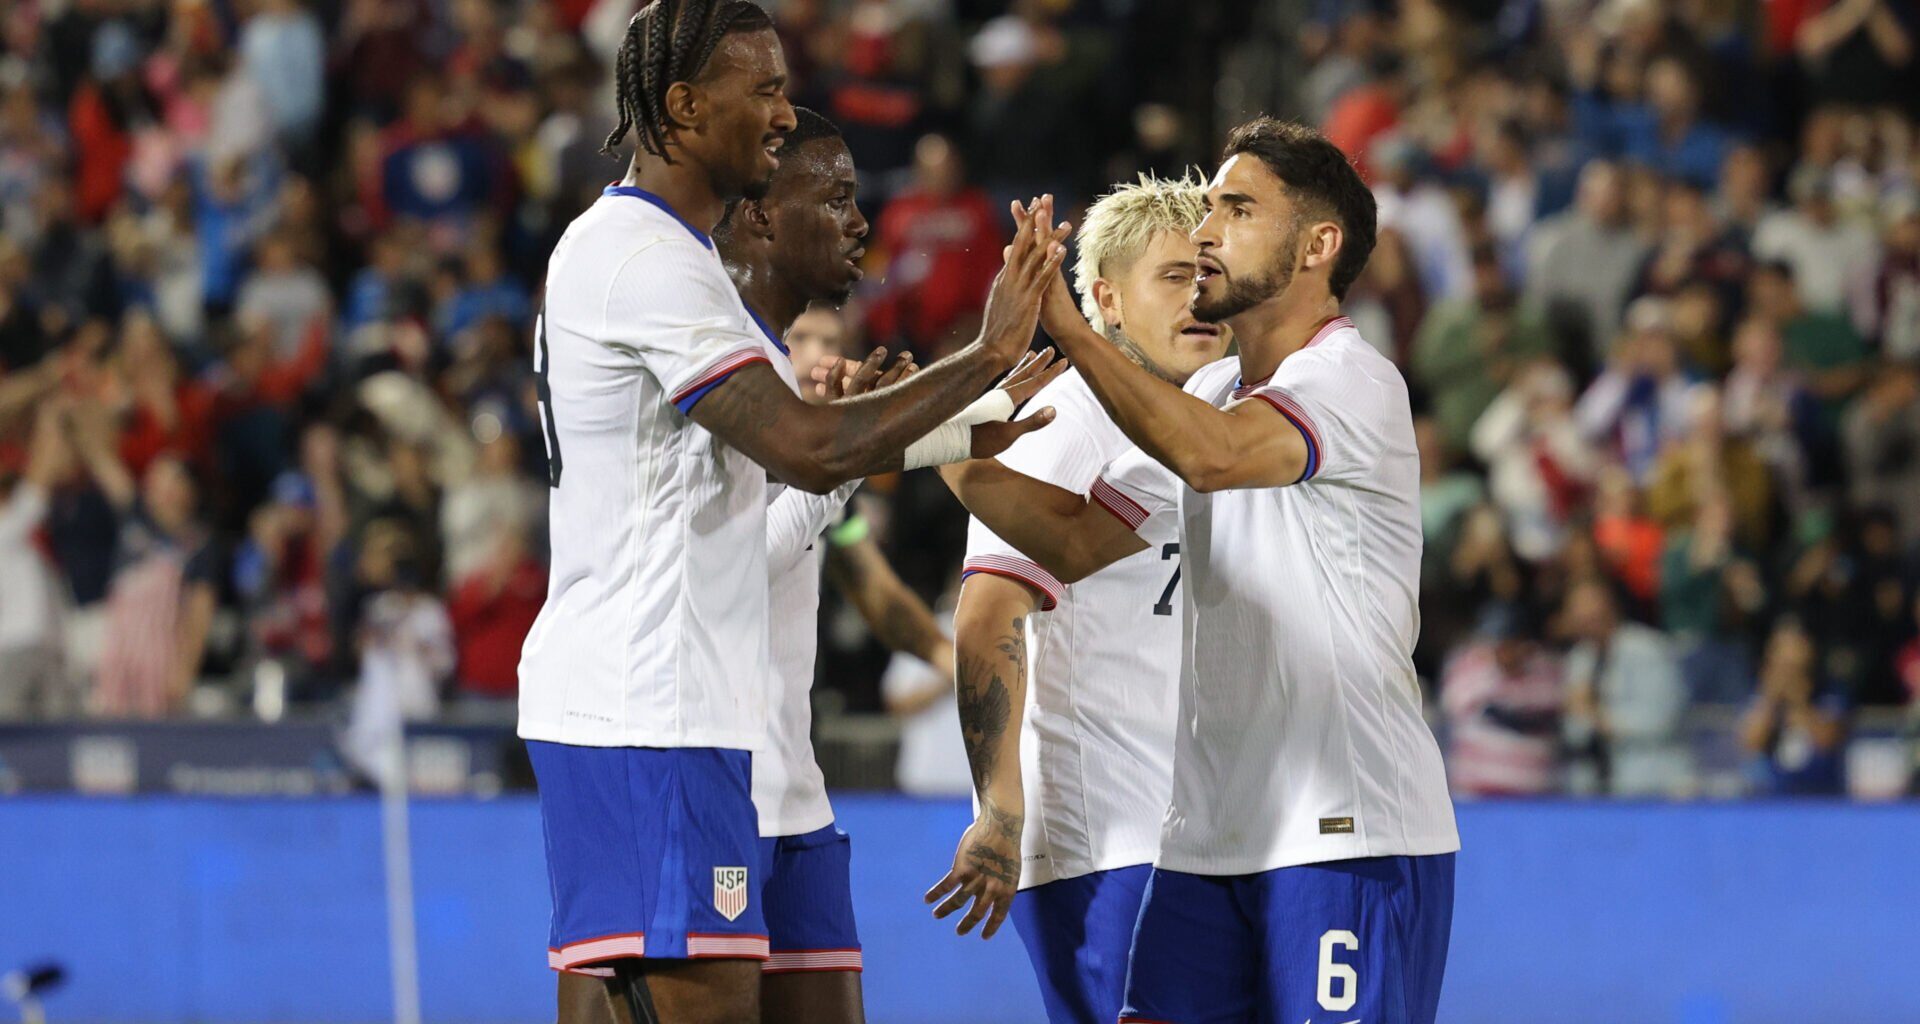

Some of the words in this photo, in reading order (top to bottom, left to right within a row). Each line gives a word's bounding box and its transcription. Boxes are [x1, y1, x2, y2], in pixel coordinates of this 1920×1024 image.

[1153, 543, 1181, 616] 7
[716, 870, 745, 890] USA
[1317, 929, 1359, 1012] 6
